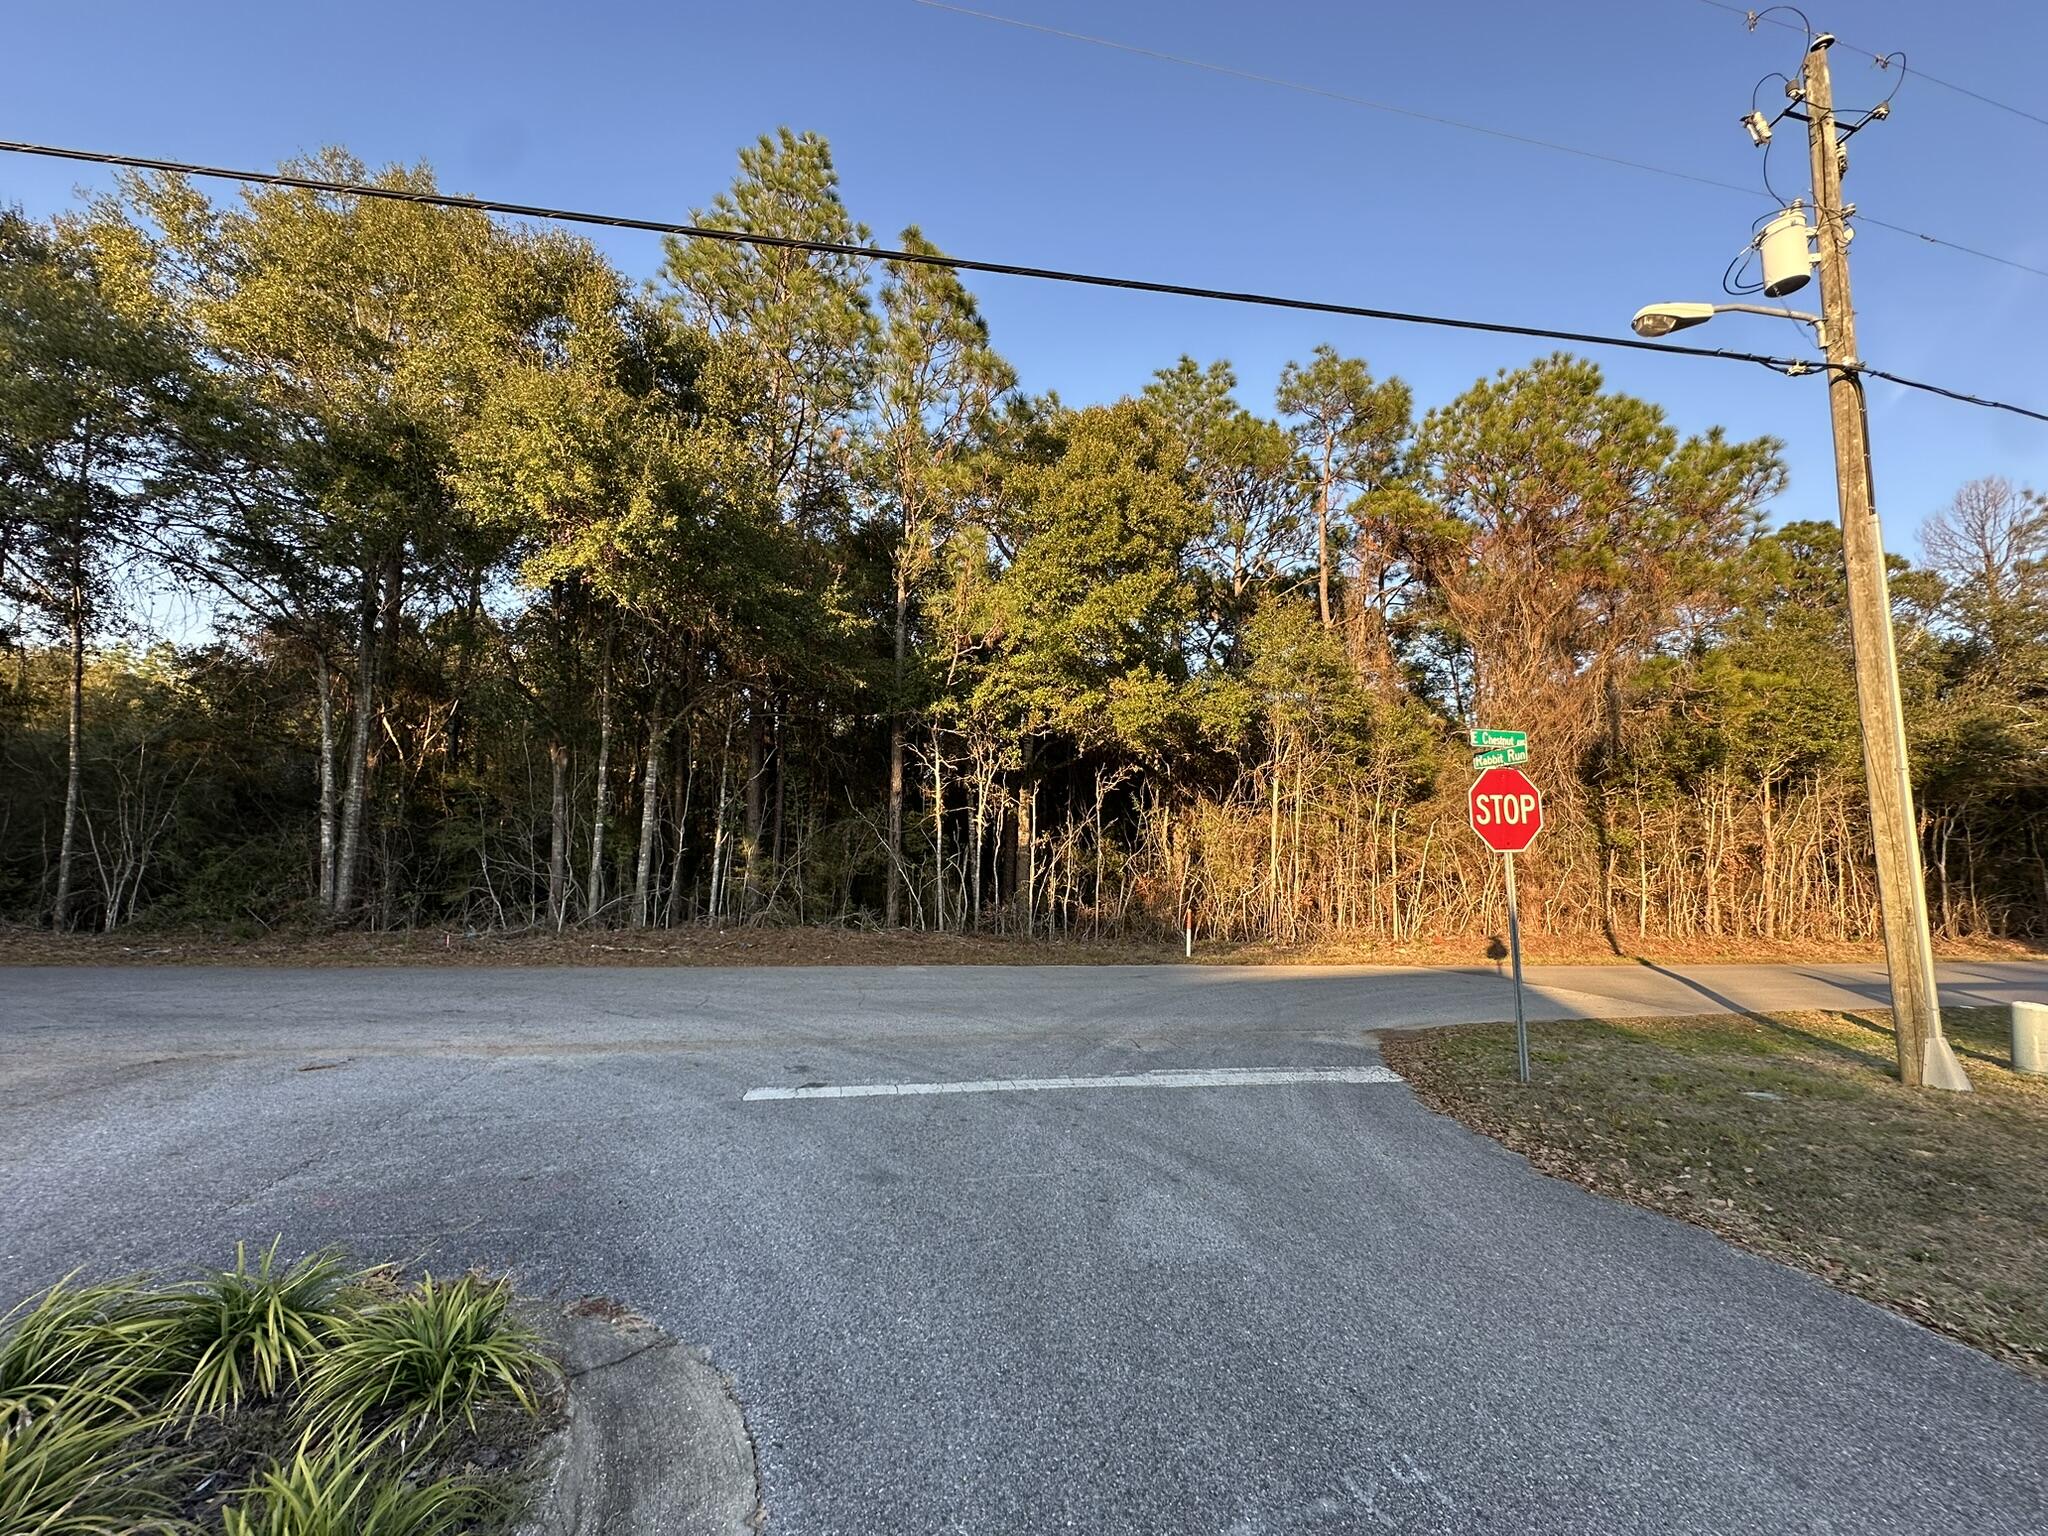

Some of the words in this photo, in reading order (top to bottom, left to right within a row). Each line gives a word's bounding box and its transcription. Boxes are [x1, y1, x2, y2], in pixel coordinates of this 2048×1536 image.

[1471, 732, 1478, 743] E
[1482, 732, 1514, 745] Chestnut
[1507, 749, 1525, 762] Run
[1476, 794, 1535, 825] STOP
